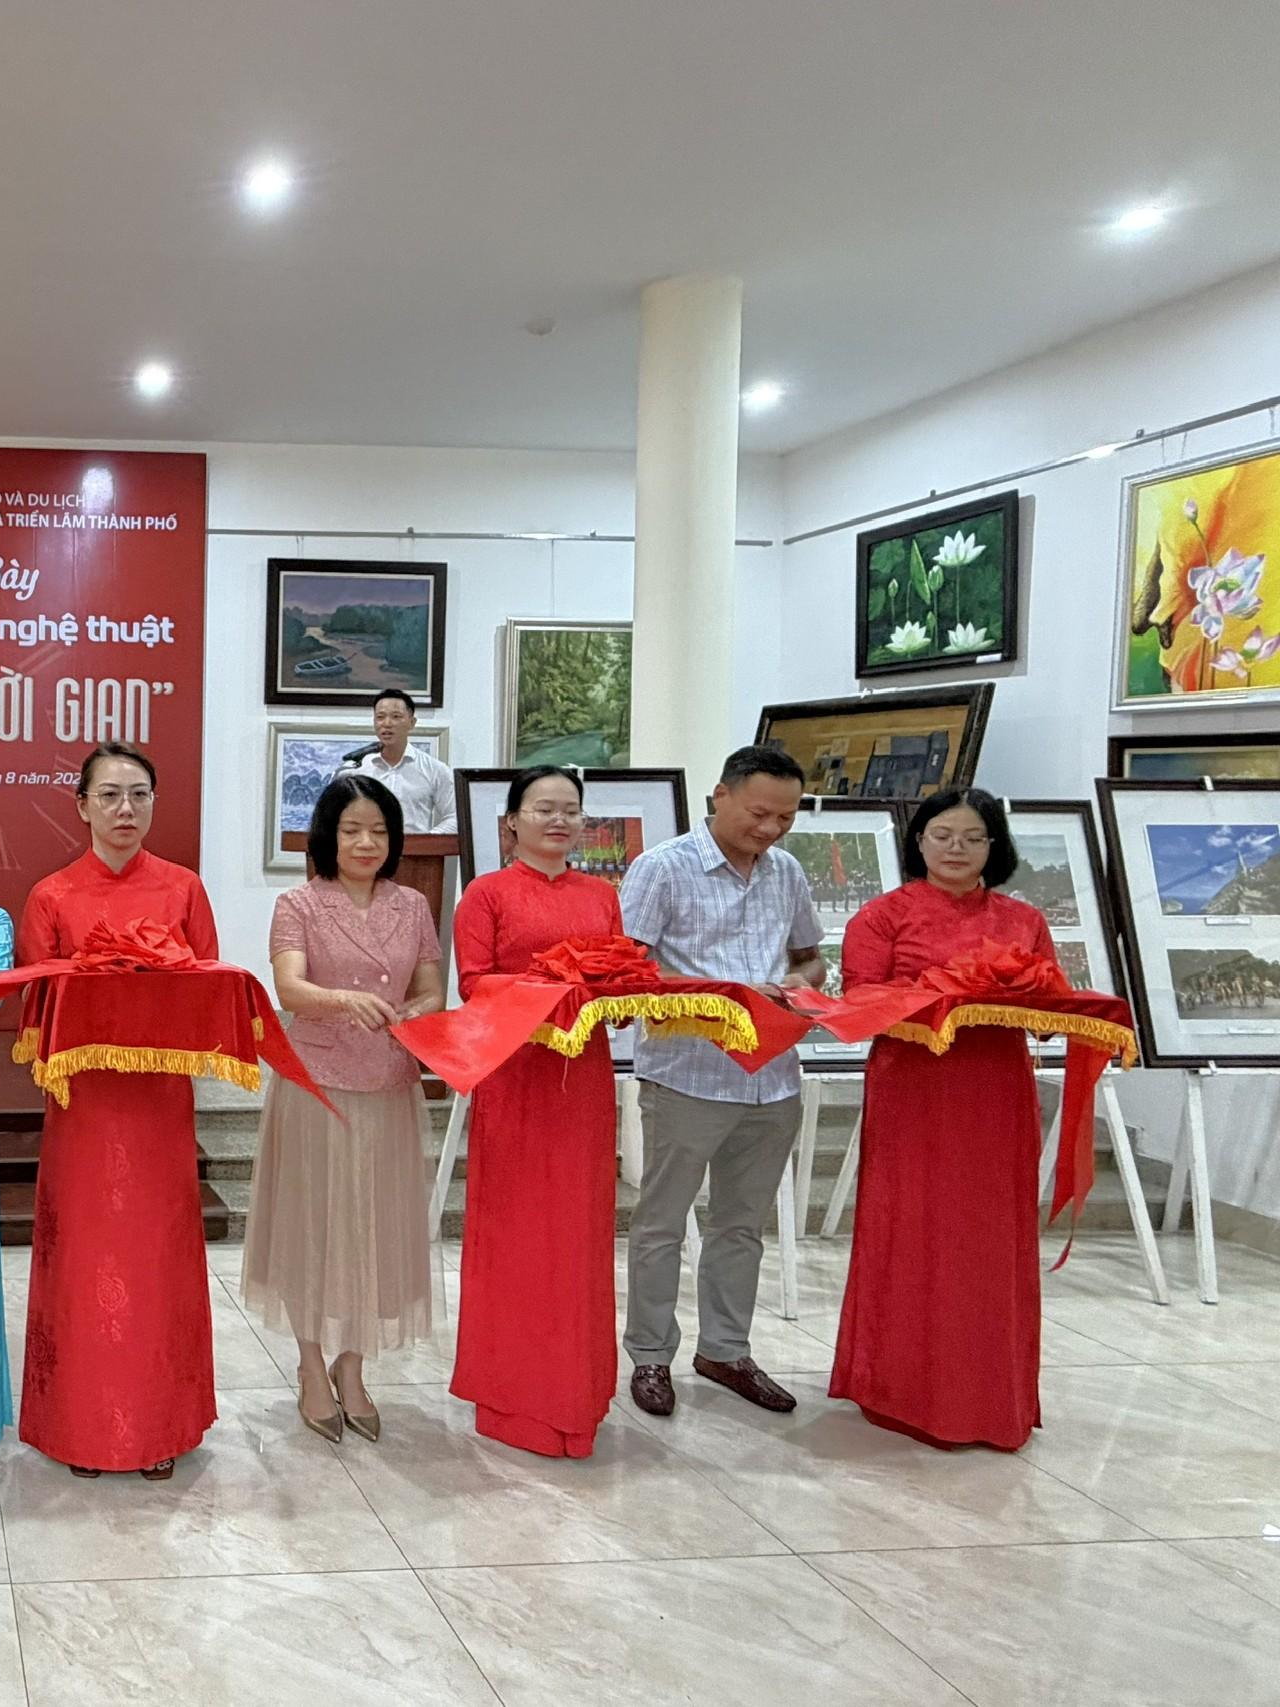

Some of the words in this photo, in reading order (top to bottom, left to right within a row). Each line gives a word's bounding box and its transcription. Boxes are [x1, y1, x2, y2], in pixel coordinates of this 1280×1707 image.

[4, 490, 24, 507] VÀ
[27, 493, 50, 507] DU
[53, 494, 86, 510] LỊCH
[6, 510, 49, 529] TRIỂN
[88, 511, 141, 530] THÀNH
[145, 513, 177, 531] PHỐ
[86, 614, 175, 648] thuật
[5, 771, 16, 784] 8
[19, 772, 50, 785] năm
[53, 772, 82, 785] 202
